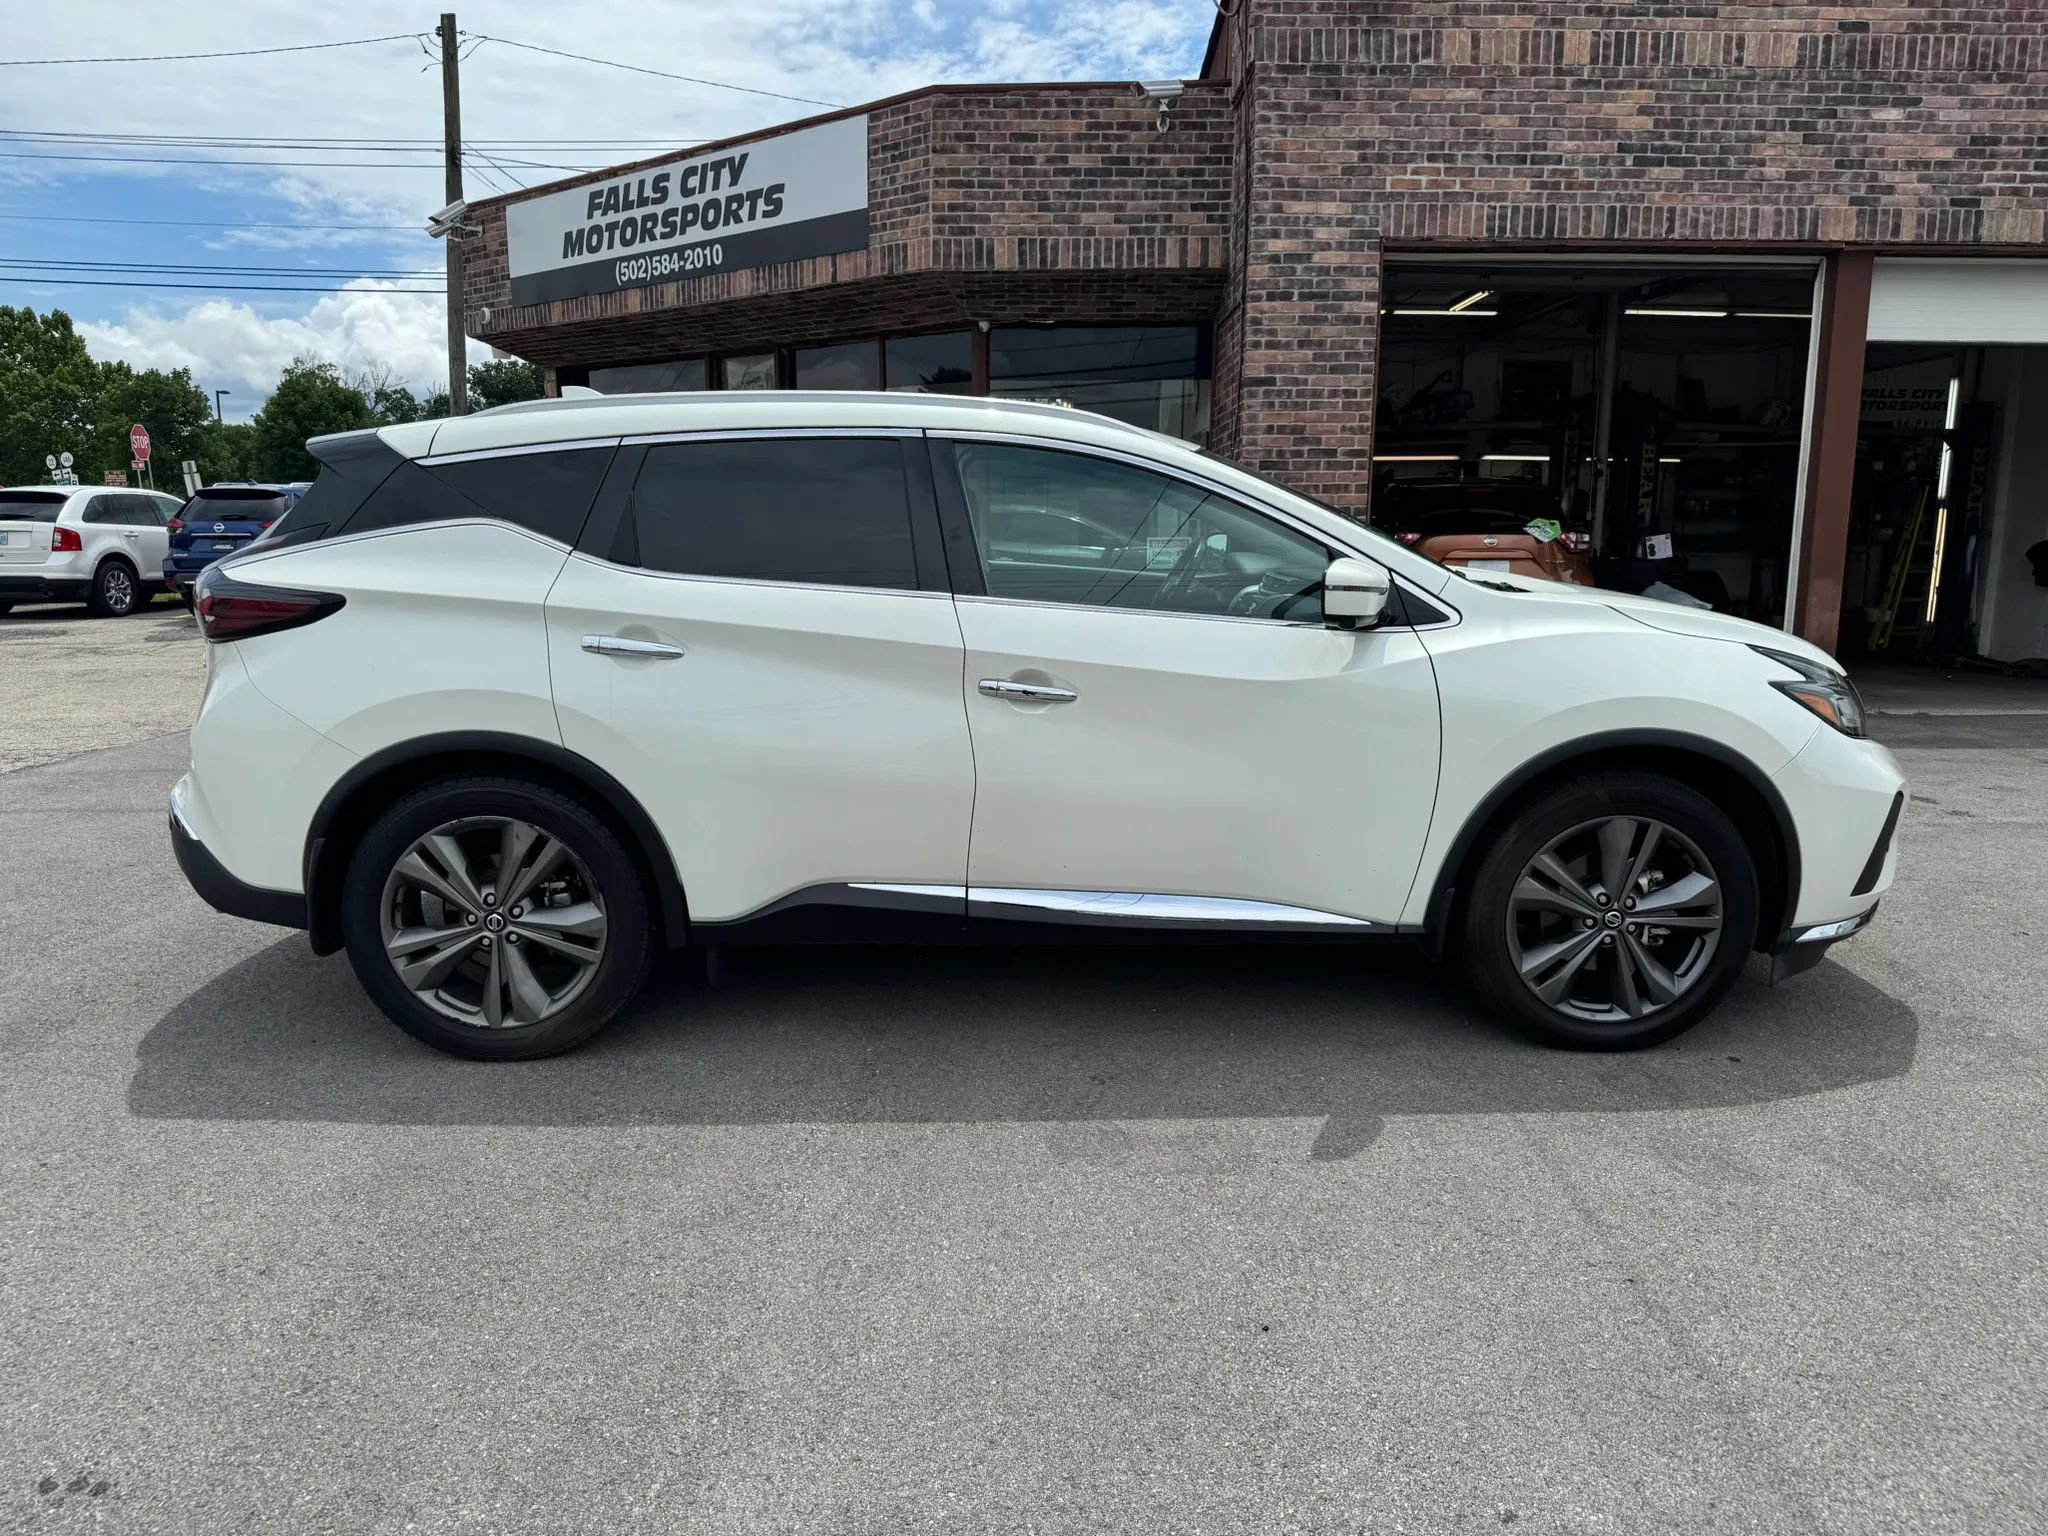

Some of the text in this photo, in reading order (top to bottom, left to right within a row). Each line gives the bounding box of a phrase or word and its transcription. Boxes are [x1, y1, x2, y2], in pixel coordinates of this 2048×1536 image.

[586, 152, 750, 220] FALLS CITY
[562, 183, 785, 259] MOTORSPORTS
[615, 243, 723, 286] (502)584-2010
[1911, 389, 1946, 399] CITY
[132, 435, 149, 449] STOP
[1638, 441, 1657, 514] BEAR
